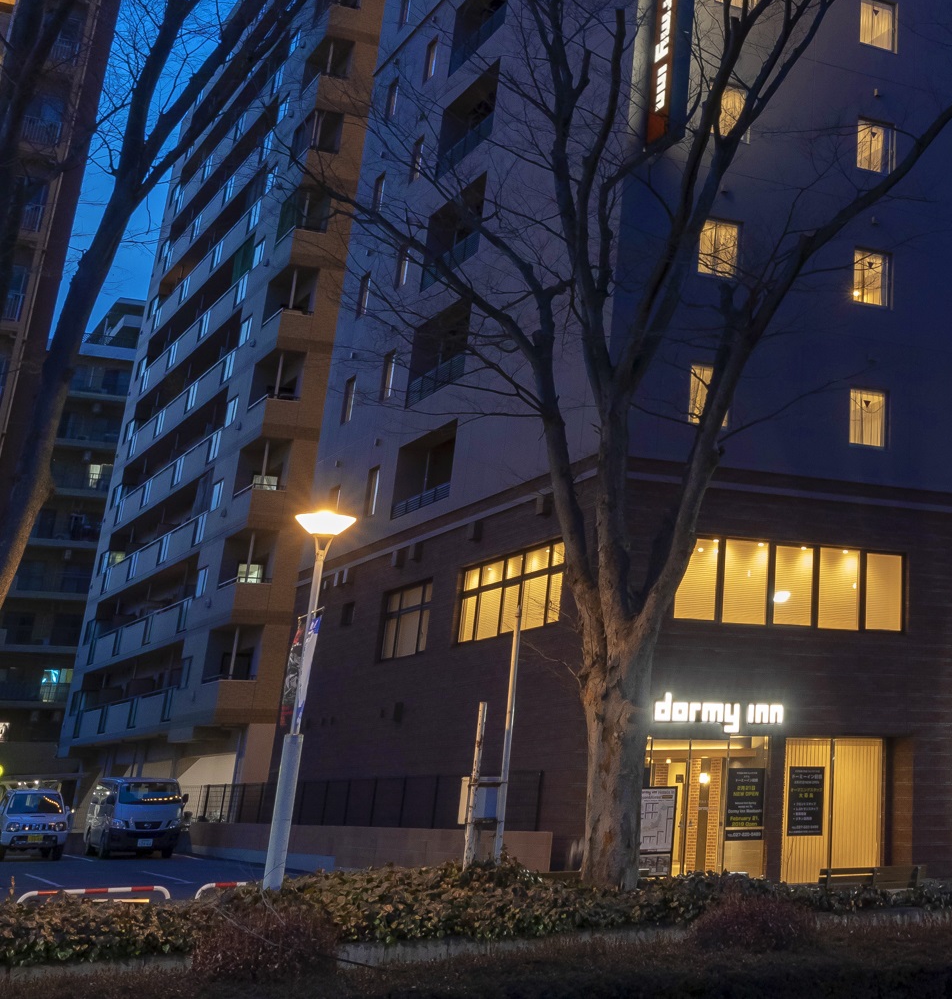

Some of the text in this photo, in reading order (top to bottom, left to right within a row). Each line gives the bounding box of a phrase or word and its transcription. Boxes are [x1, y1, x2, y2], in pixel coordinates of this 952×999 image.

[655, 63, 668, 112] inn
[653, 691, 785, 734] dormy inn
